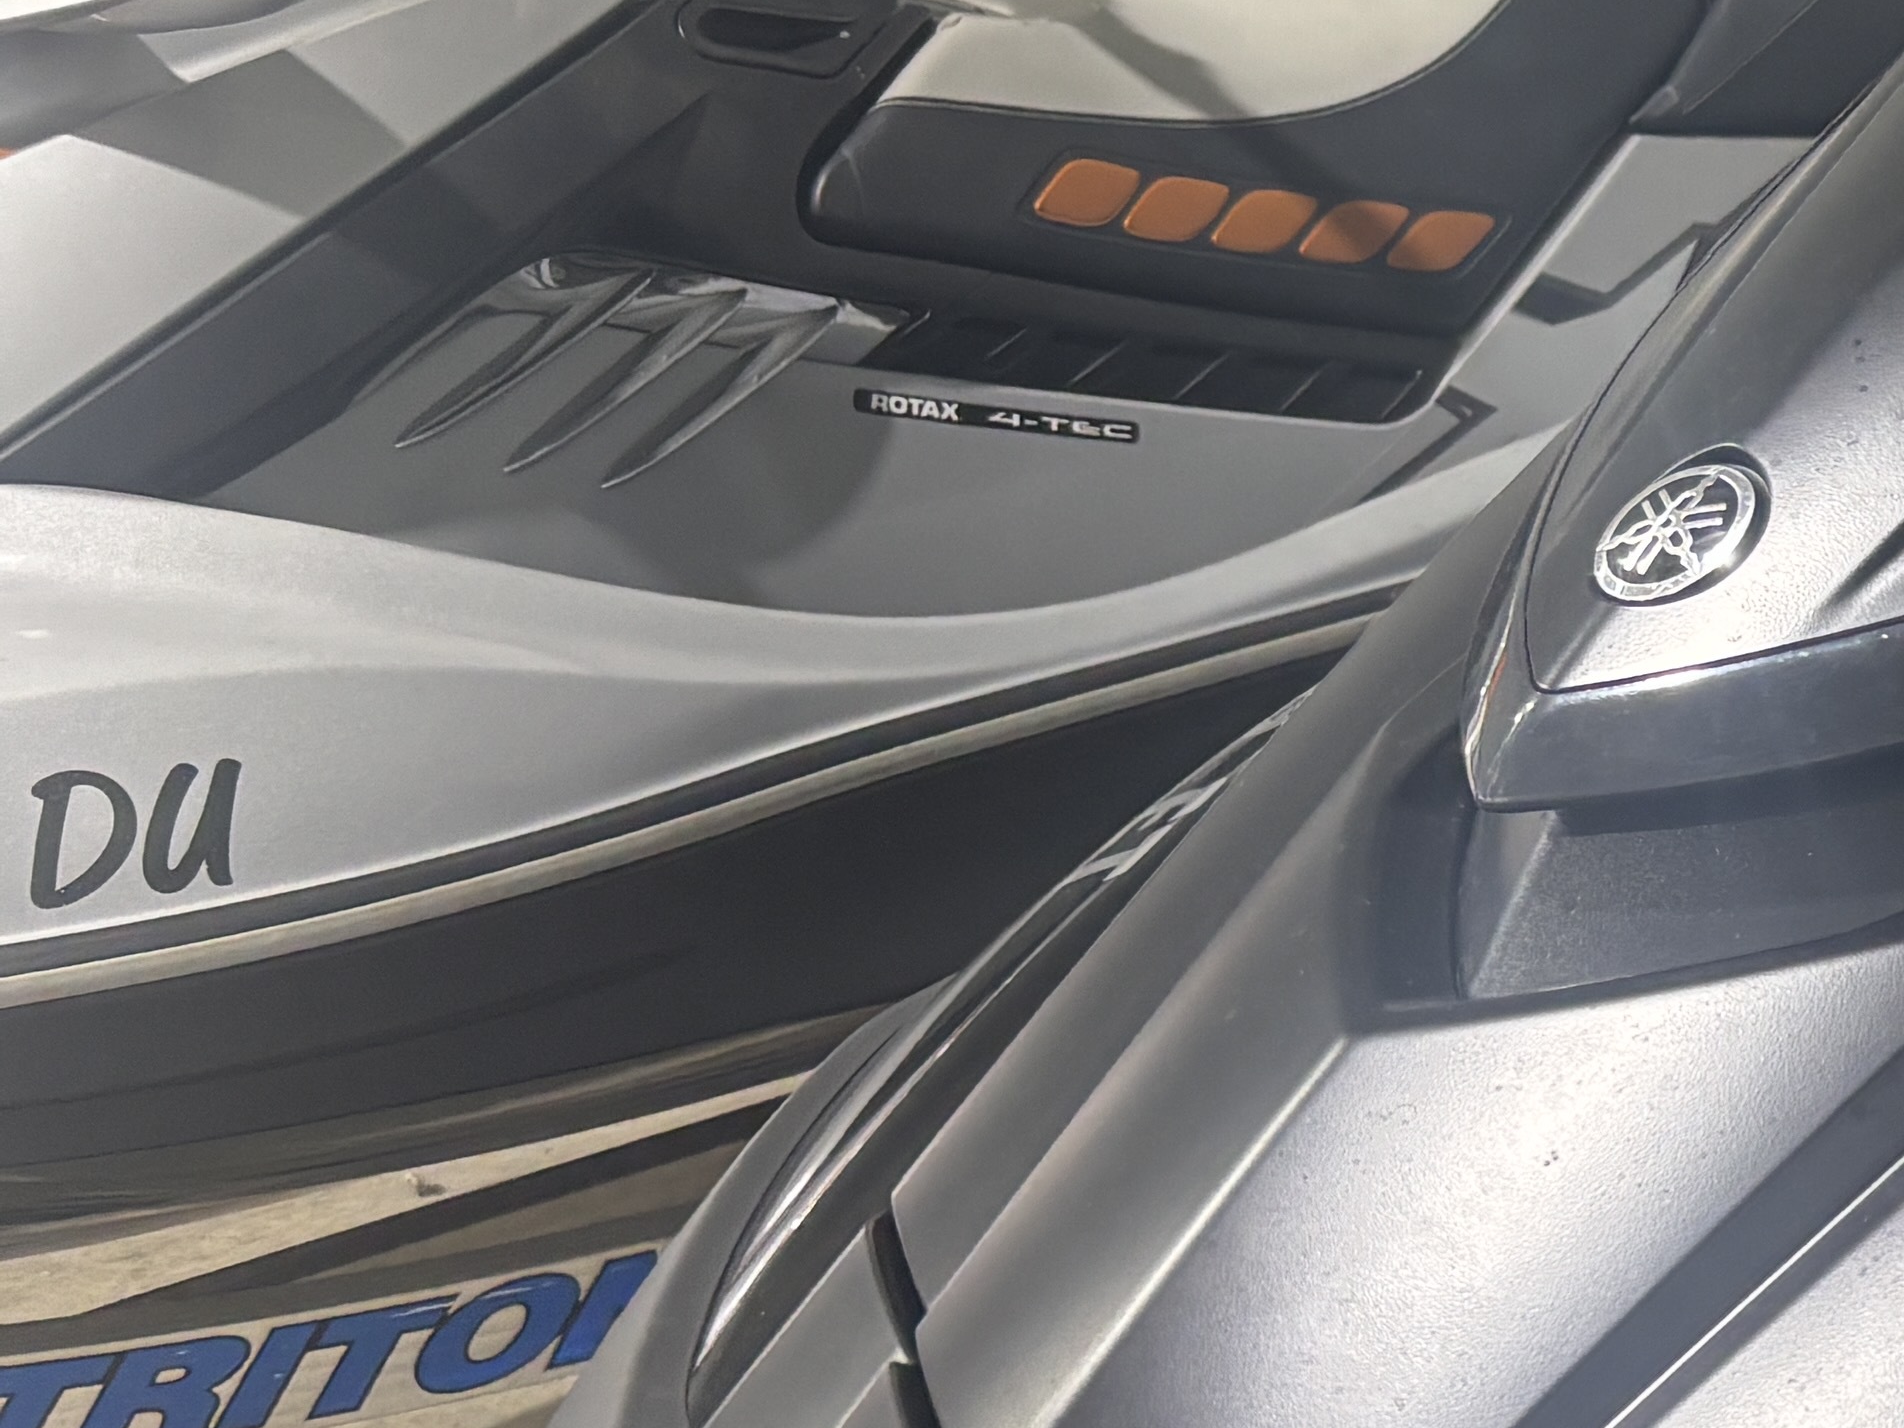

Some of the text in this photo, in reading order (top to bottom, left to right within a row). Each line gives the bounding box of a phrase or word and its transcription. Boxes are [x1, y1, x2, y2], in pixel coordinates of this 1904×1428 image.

[871, 393, 1132, 439] ROTAX 4-TEC
[30, 758, 242, 909] DU
